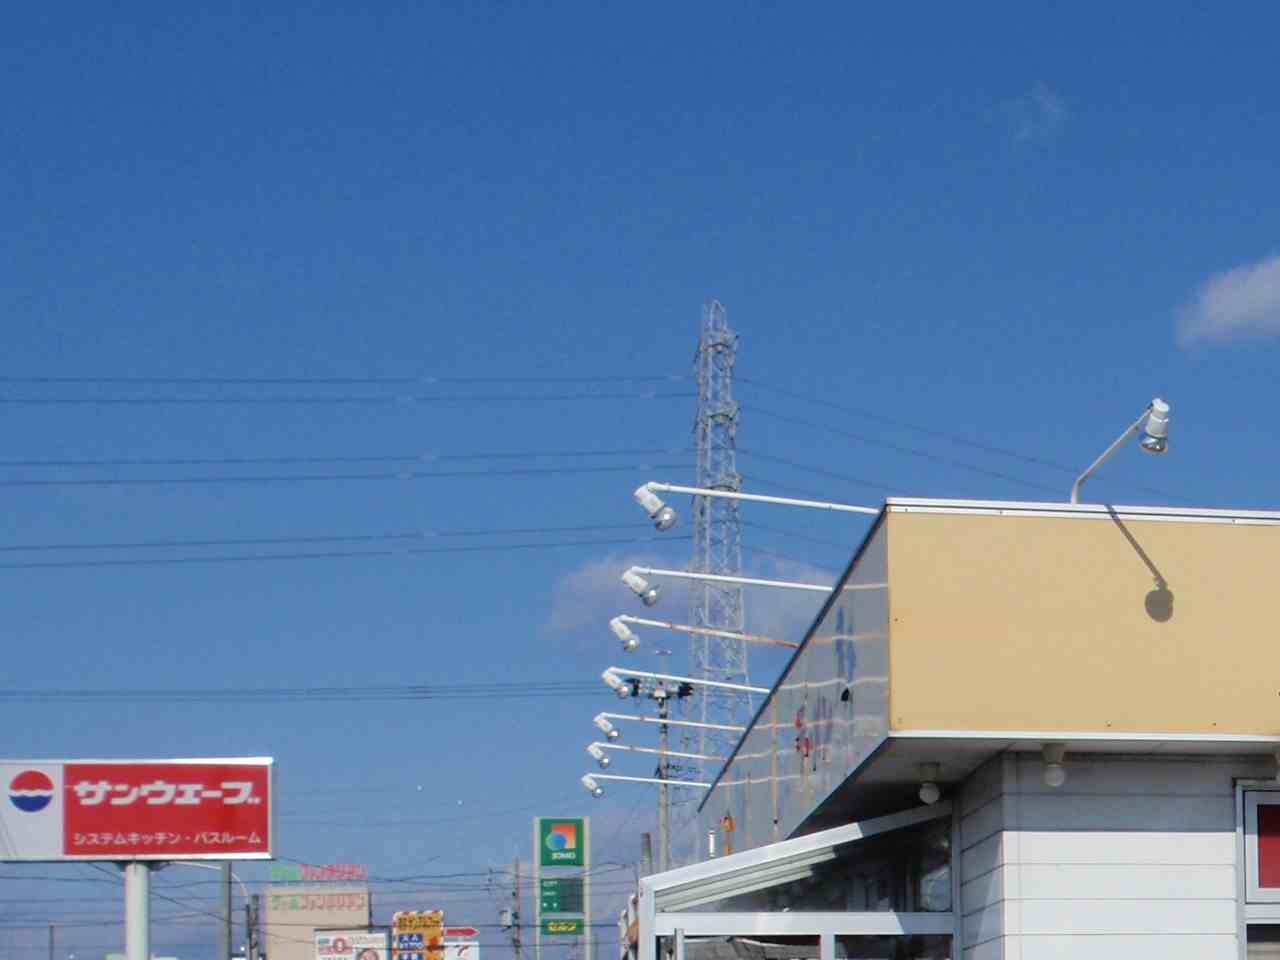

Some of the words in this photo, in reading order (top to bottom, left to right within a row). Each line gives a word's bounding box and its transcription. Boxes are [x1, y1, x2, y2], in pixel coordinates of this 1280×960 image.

[74, 831, 261, 845] システムキッチン・バスルーム
